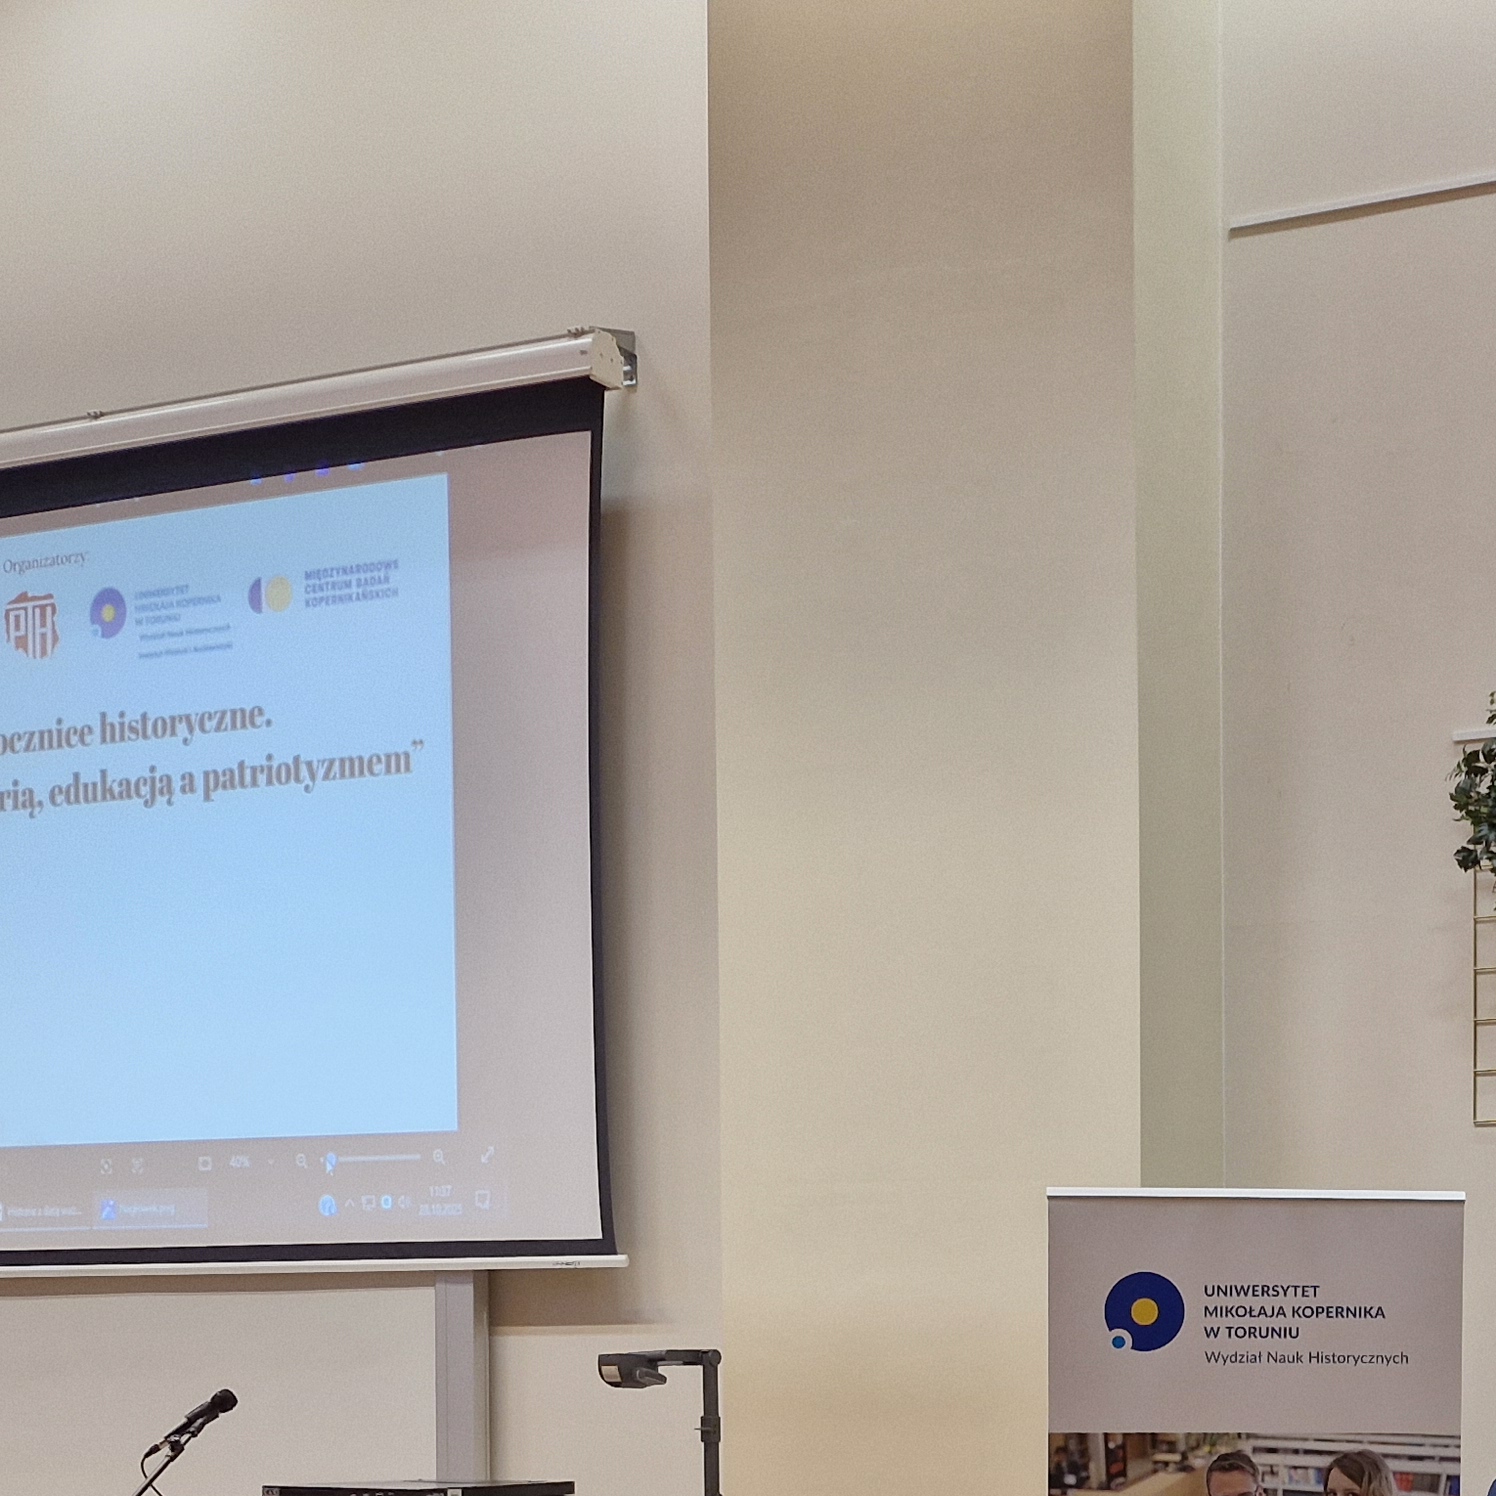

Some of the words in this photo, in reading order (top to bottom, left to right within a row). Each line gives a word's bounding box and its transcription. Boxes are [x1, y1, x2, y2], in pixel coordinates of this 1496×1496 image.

[3, 552, 87, 575] Organizatorzy
[304, 559, 400, 582] MIĘDZYNARODOWE
[304, 578, 352, 595] CENTRUM
[305, 587, 399, 608] KOPERNIKAŃSKICH
[100, 705, 273, 747] historyczne.
[49, 765, 174, 809] edukacją
[180, 771, 196, 795] a
[1203, 1284, 1321, 1299] UNIWERSYTET
[1203, 1305, 1288, 1319] MIKOŁAJA
[1291, 1305, 1387, 1319] KOPERNIKA
[1203, 1326, 1221, 1339] W
[1225, 1326, 1301, 1339] TORUNIU
[1204, 1350, 1263, 1366] Wydział
[1266, 1350, 1304, 1365] Nauk
[1308, 1350, 1410, 1367] Historycznych
